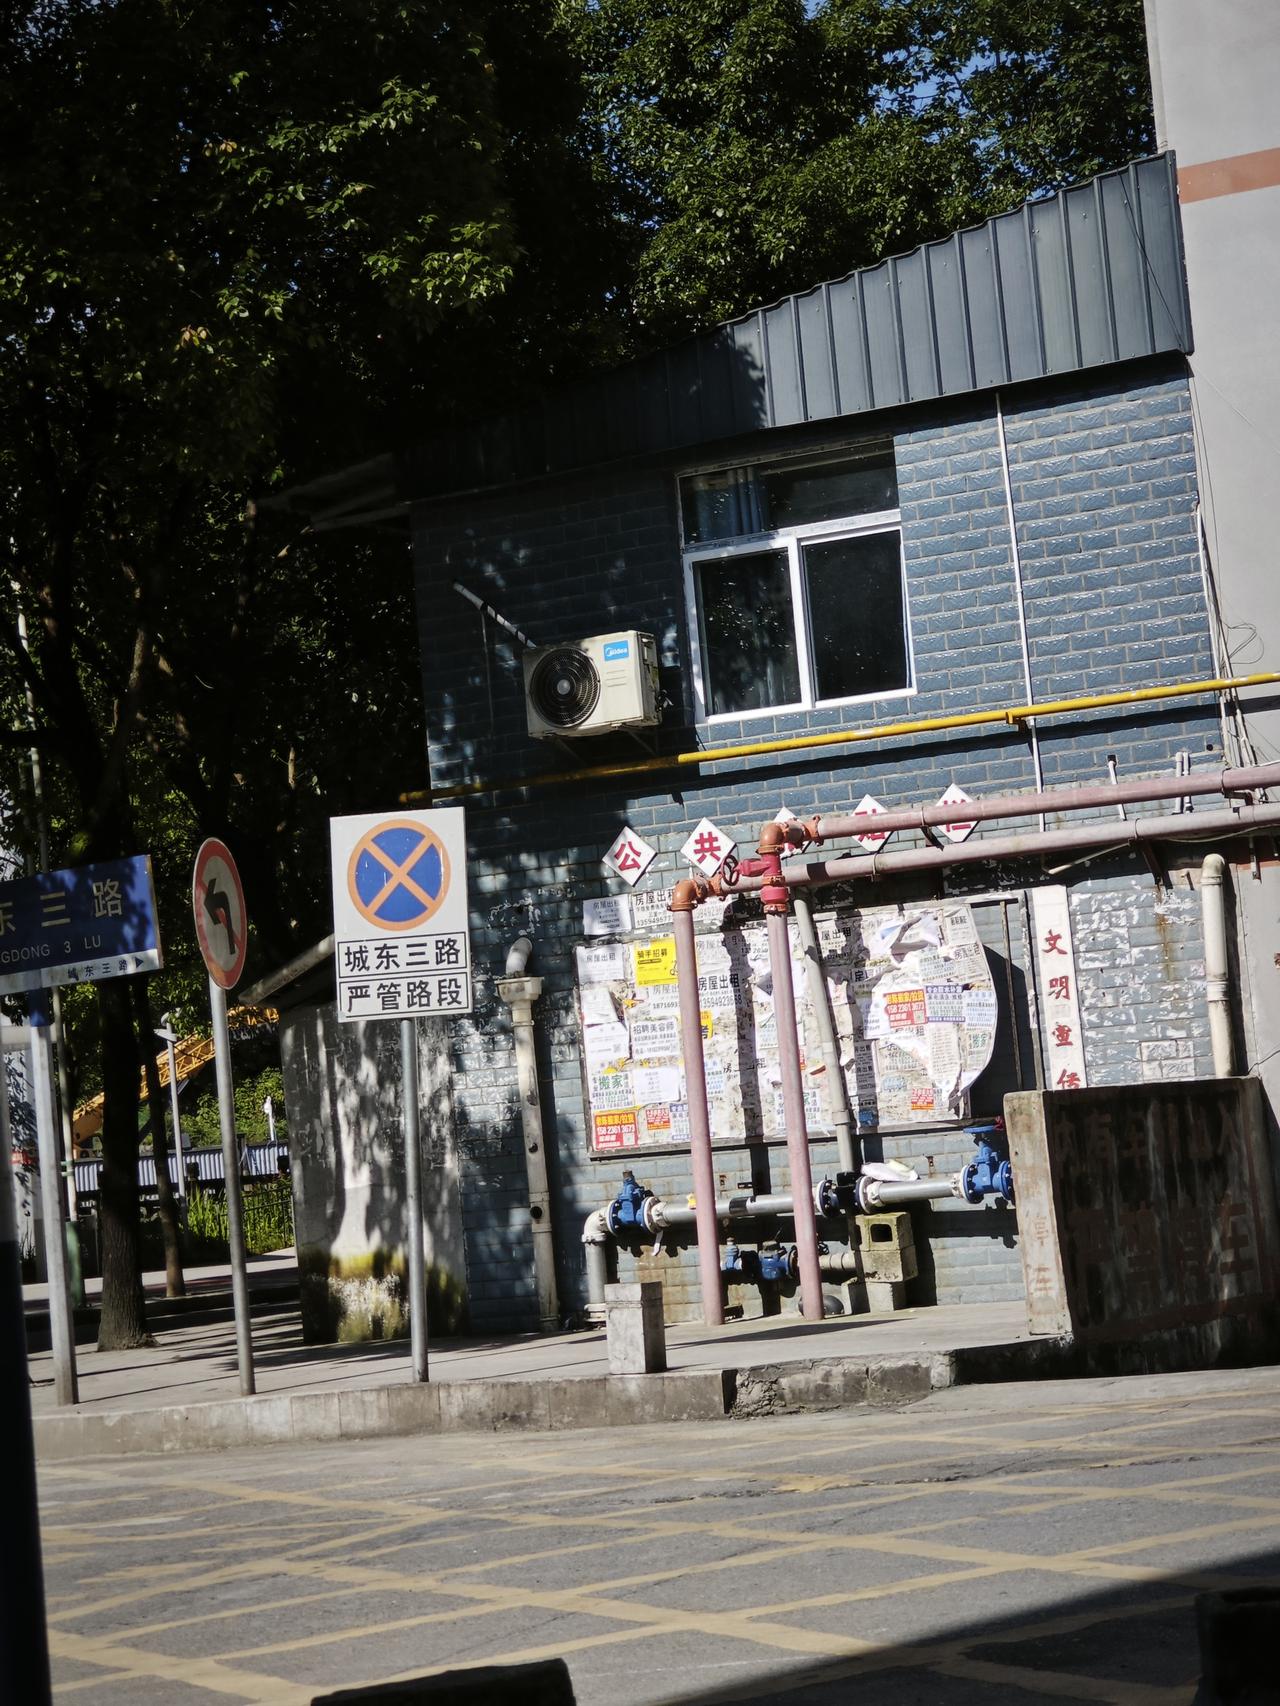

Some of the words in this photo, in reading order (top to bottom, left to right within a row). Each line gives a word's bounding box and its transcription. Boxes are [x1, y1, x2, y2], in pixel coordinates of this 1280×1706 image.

[64, 940, 72, 954] 3
[84, 935, 102, 950] LU
[345, 938, 461, 972] 城东三路
[346, 978, 462, 1013] 严管路段
[699, 974, 740, 991] 房屋出租
